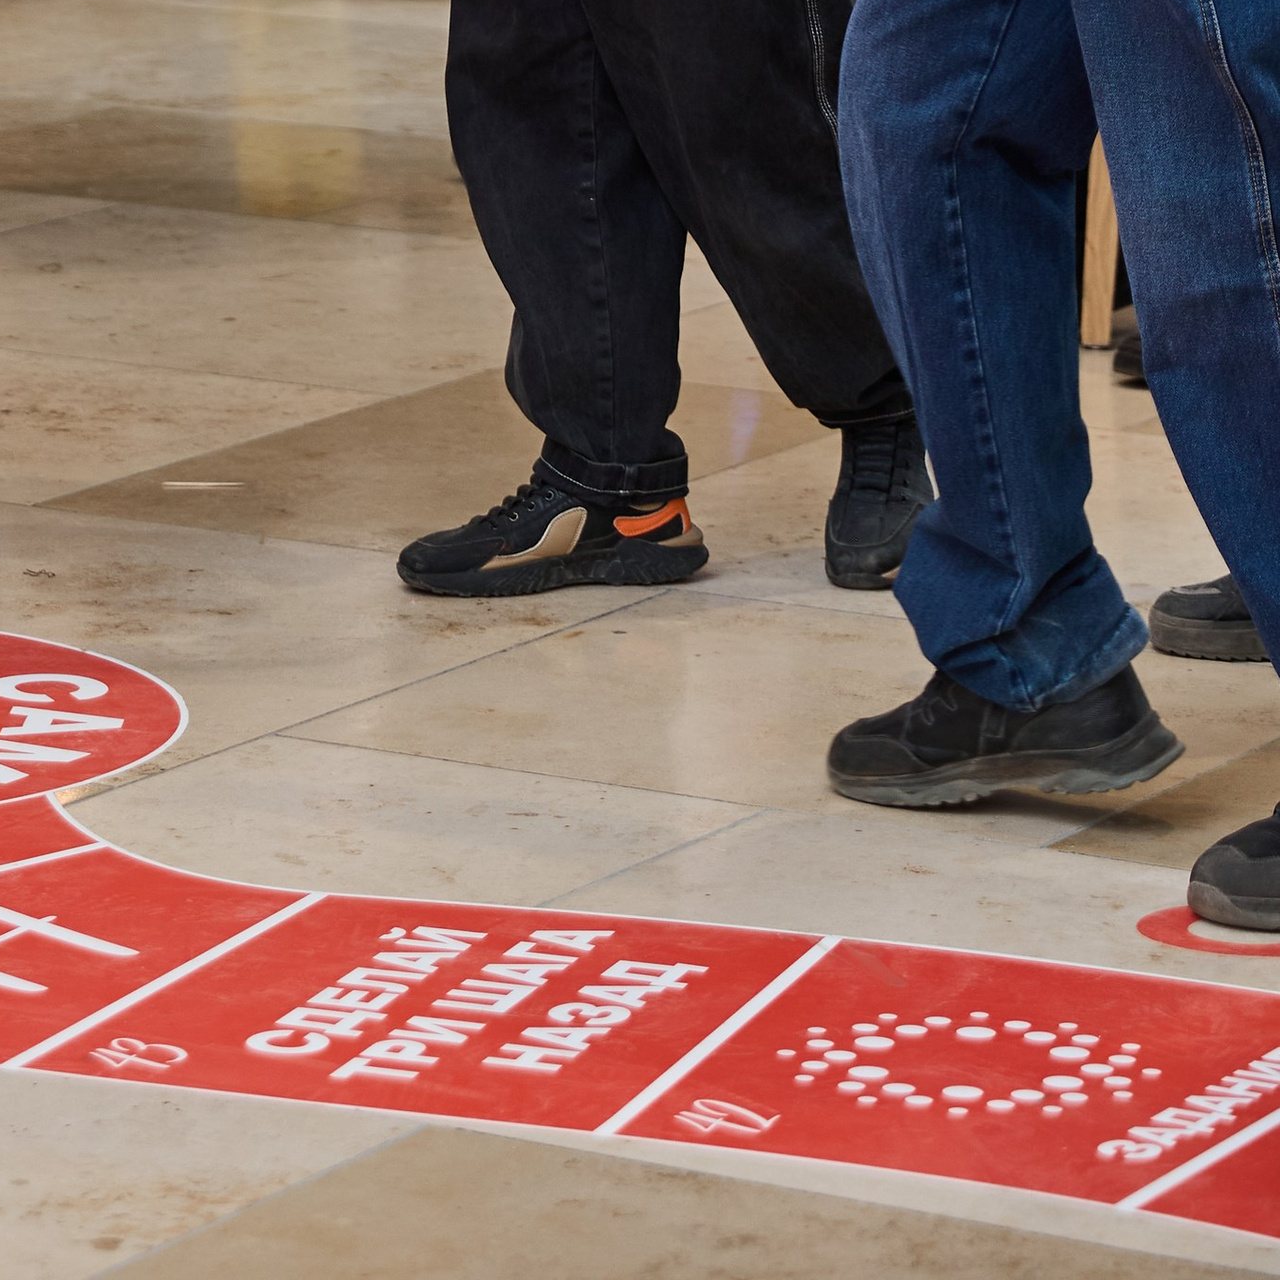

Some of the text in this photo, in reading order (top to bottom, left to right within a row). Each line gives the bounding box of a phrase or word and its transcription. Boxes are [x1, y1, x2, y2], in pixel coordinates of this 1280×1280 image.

[246, 926, 488, 1056] СДЕЛАЙ
[329, 929, 617, 1080] ТРИ ШАГА
[481, 959, 710, 1072] НАЗАД
[88, 1037, 188, 1069] 43
[674, 1098, 782, 1133] 42
